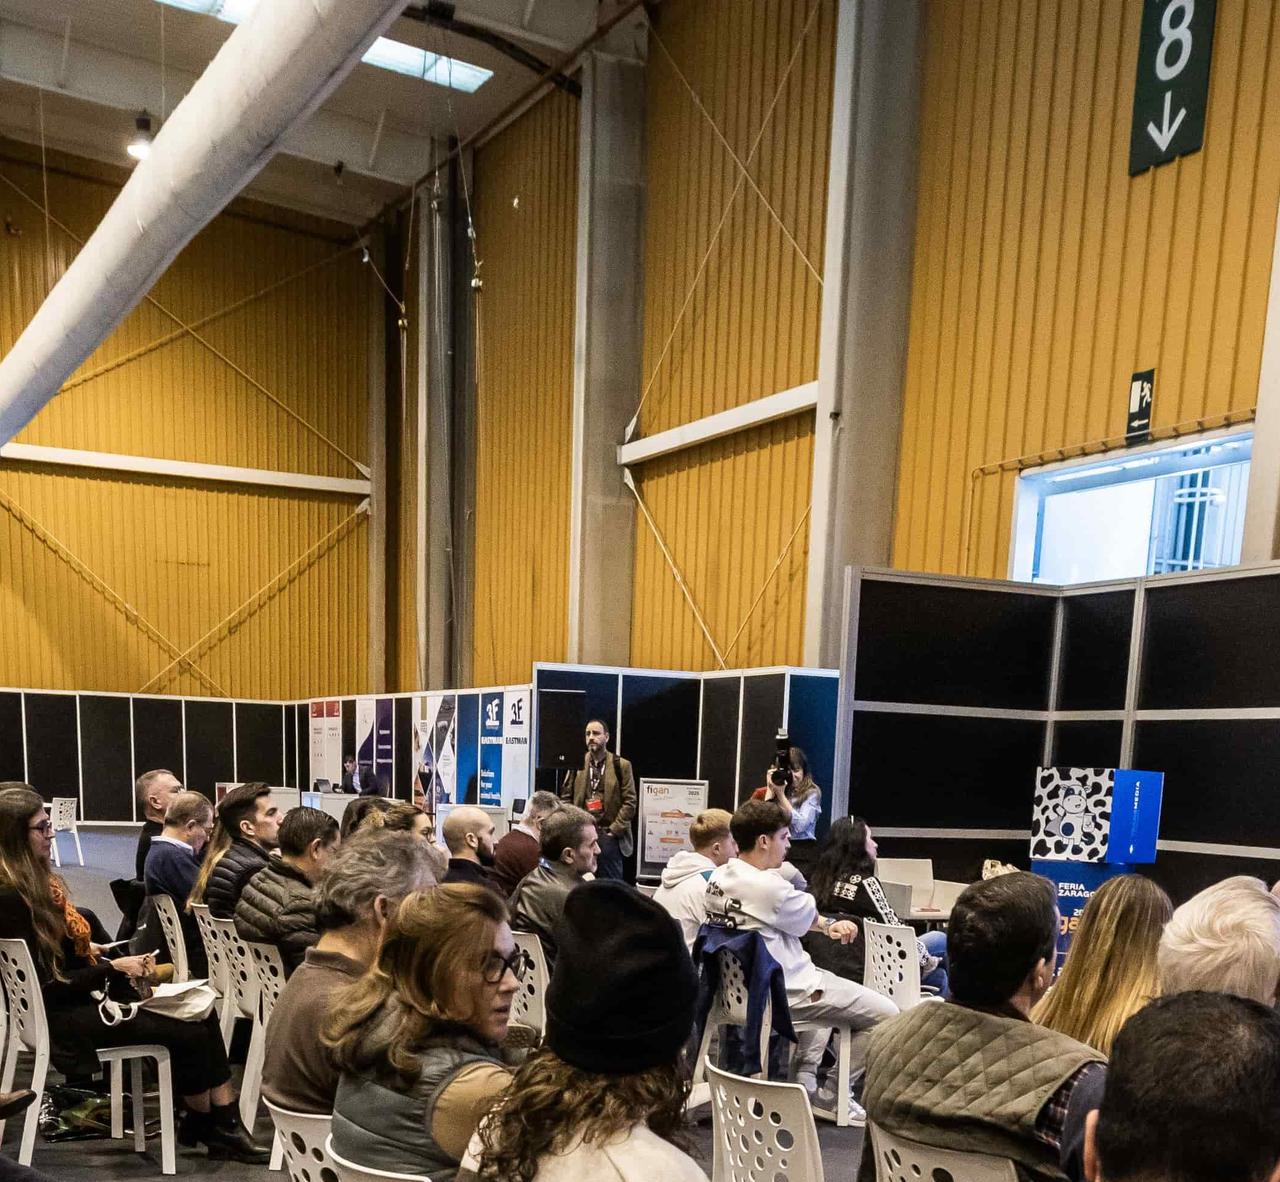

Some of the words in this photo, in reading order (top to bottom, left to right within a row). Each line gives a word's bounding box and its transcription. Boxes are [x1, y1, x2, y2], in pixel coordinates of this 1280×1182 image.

[1156, 0, 1195, 81] 8
[505, 737, 528, 745] EASTMAN
[647, 785, 670, 796] figan
[1059, 882, 1085, 891] FERIA
[1058, 889, 1095, 898] ZARAGO
